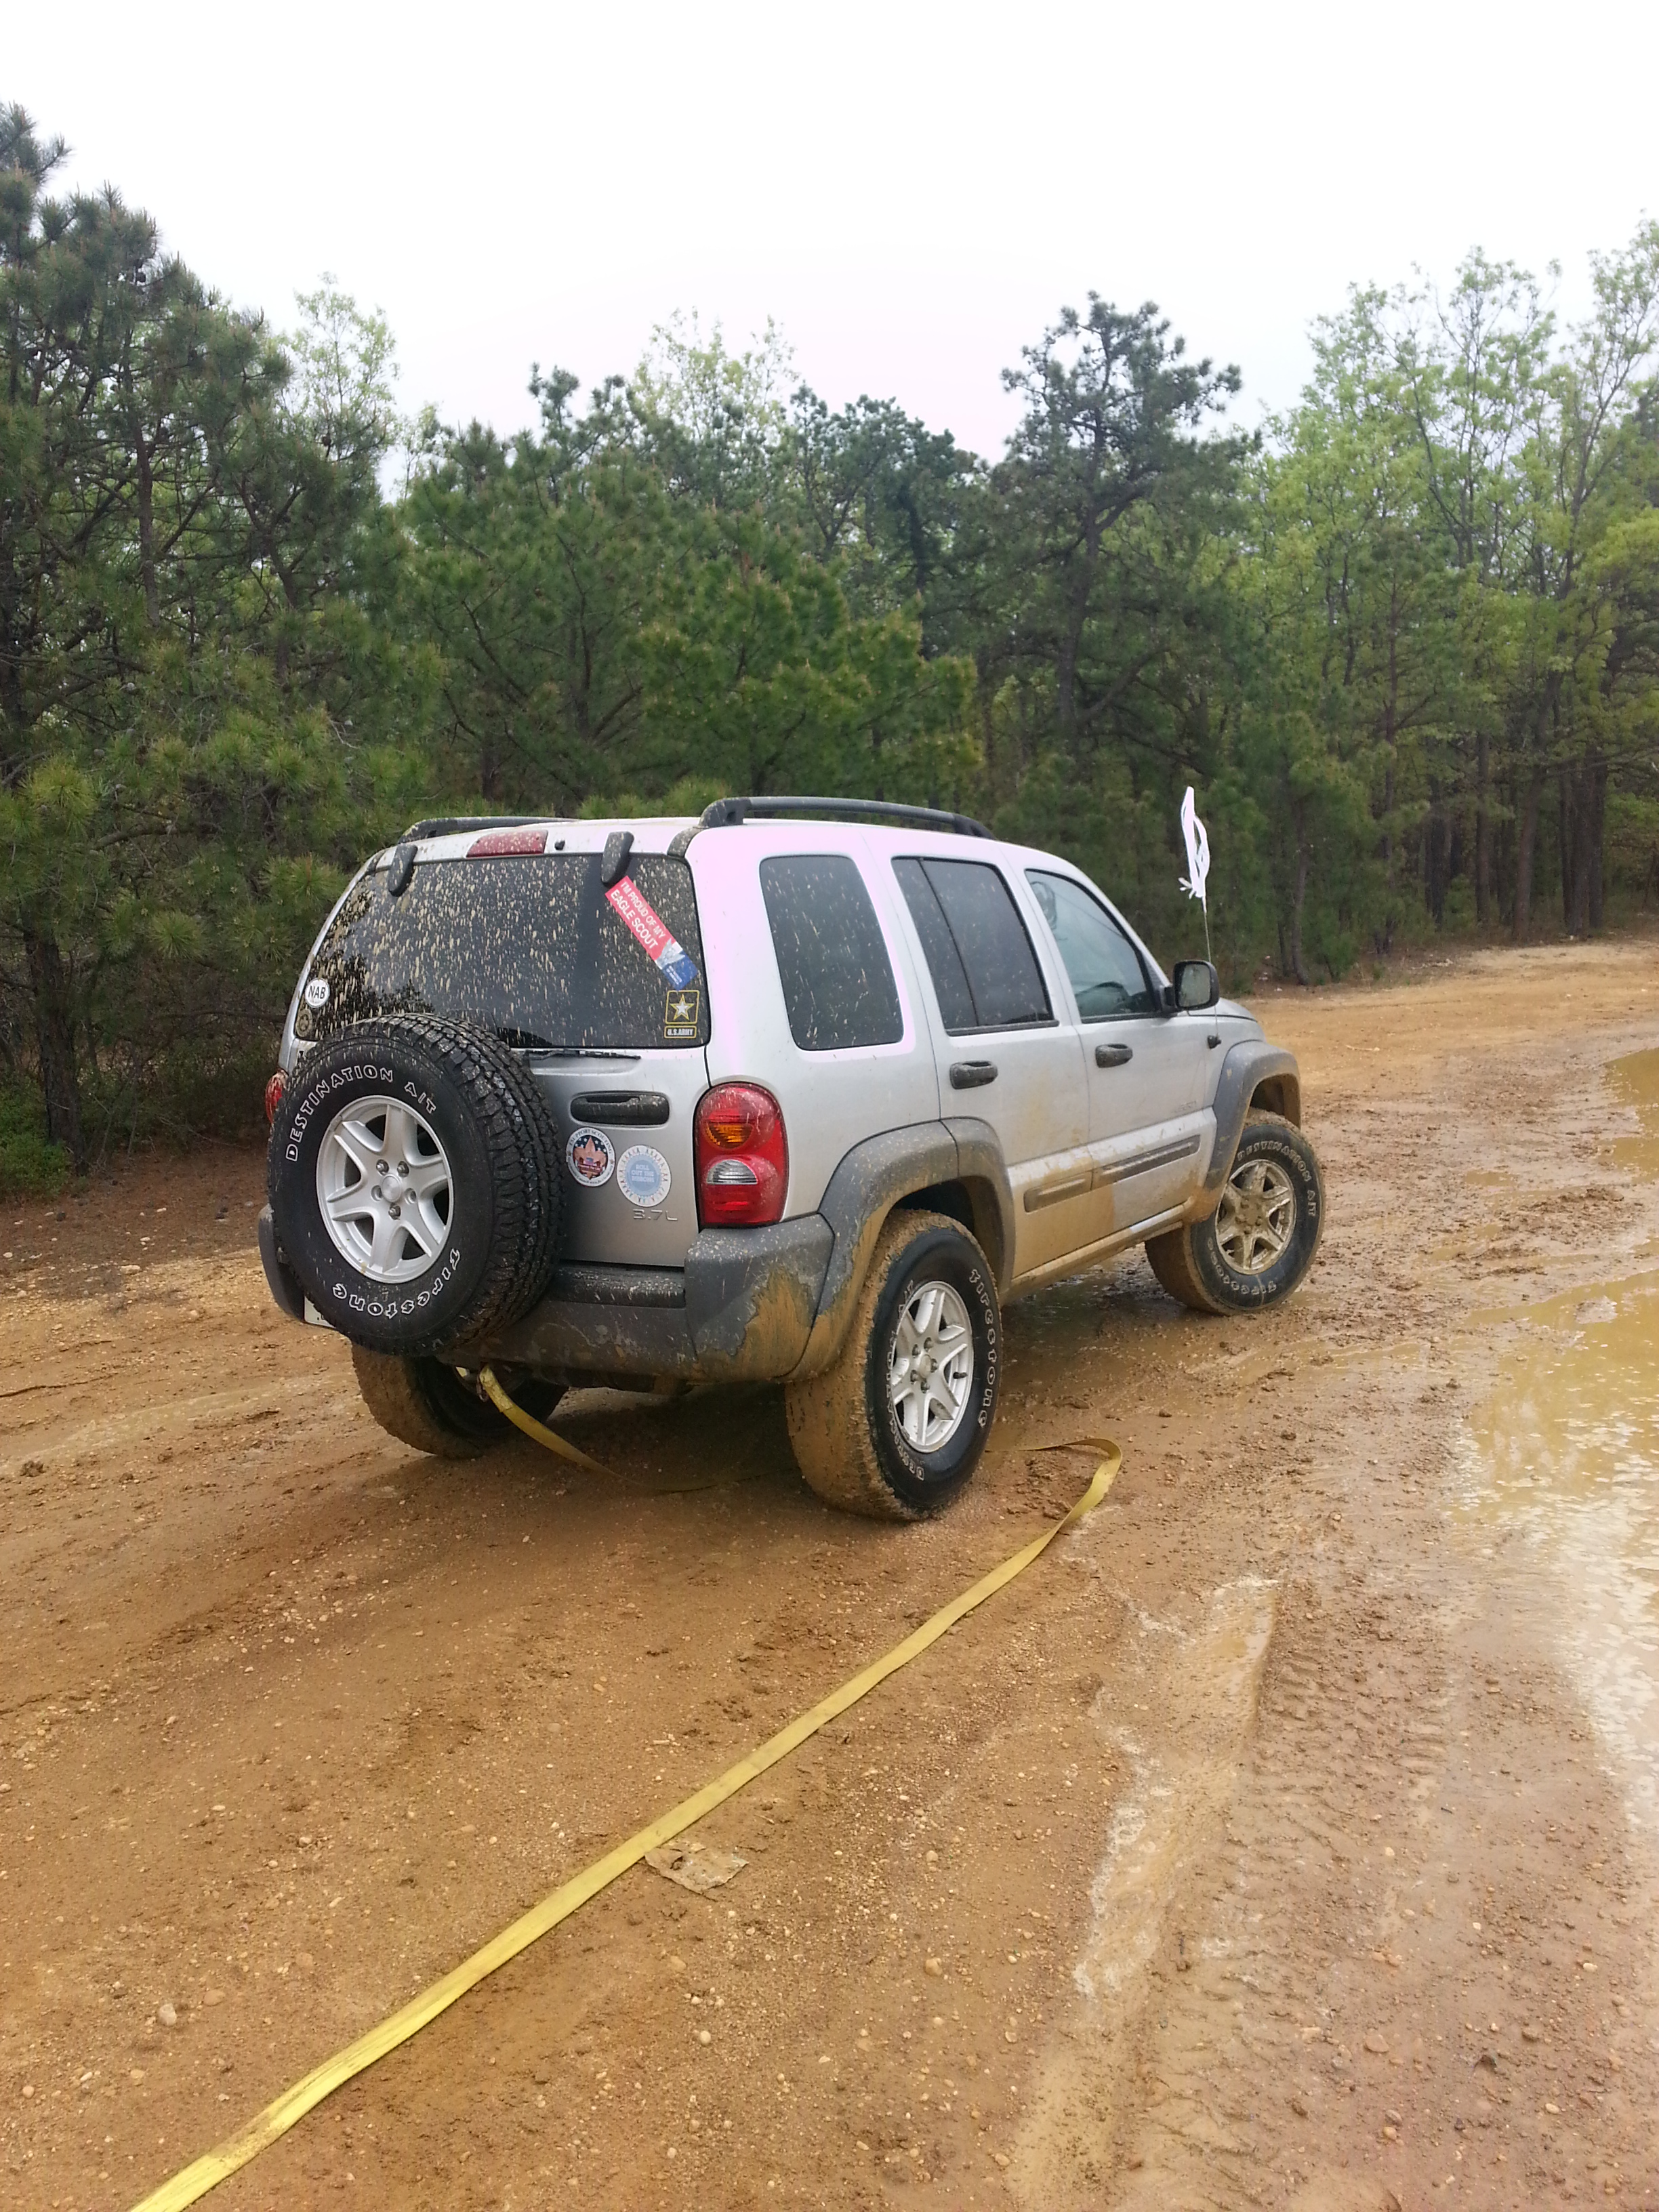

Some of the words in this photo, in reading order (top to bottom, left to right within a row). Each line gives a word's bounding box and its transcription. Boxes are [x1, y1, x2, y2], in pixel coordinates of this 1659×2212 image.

[611, 889, 636, 920] EAGLE
[631, 918, 658, 949] SCOUT
[628, 891, 649, 916] PROUD
[646, 916, 657, 926] OF
[653, 926, 666, 939] MY
[308, 985, 326, 1000] NAB
[285, 1064, 393, 1162] DESTINATION
[632, 1208, 678, 1221] 3.7L
[332, 1248, 461, 1319] Firestone
